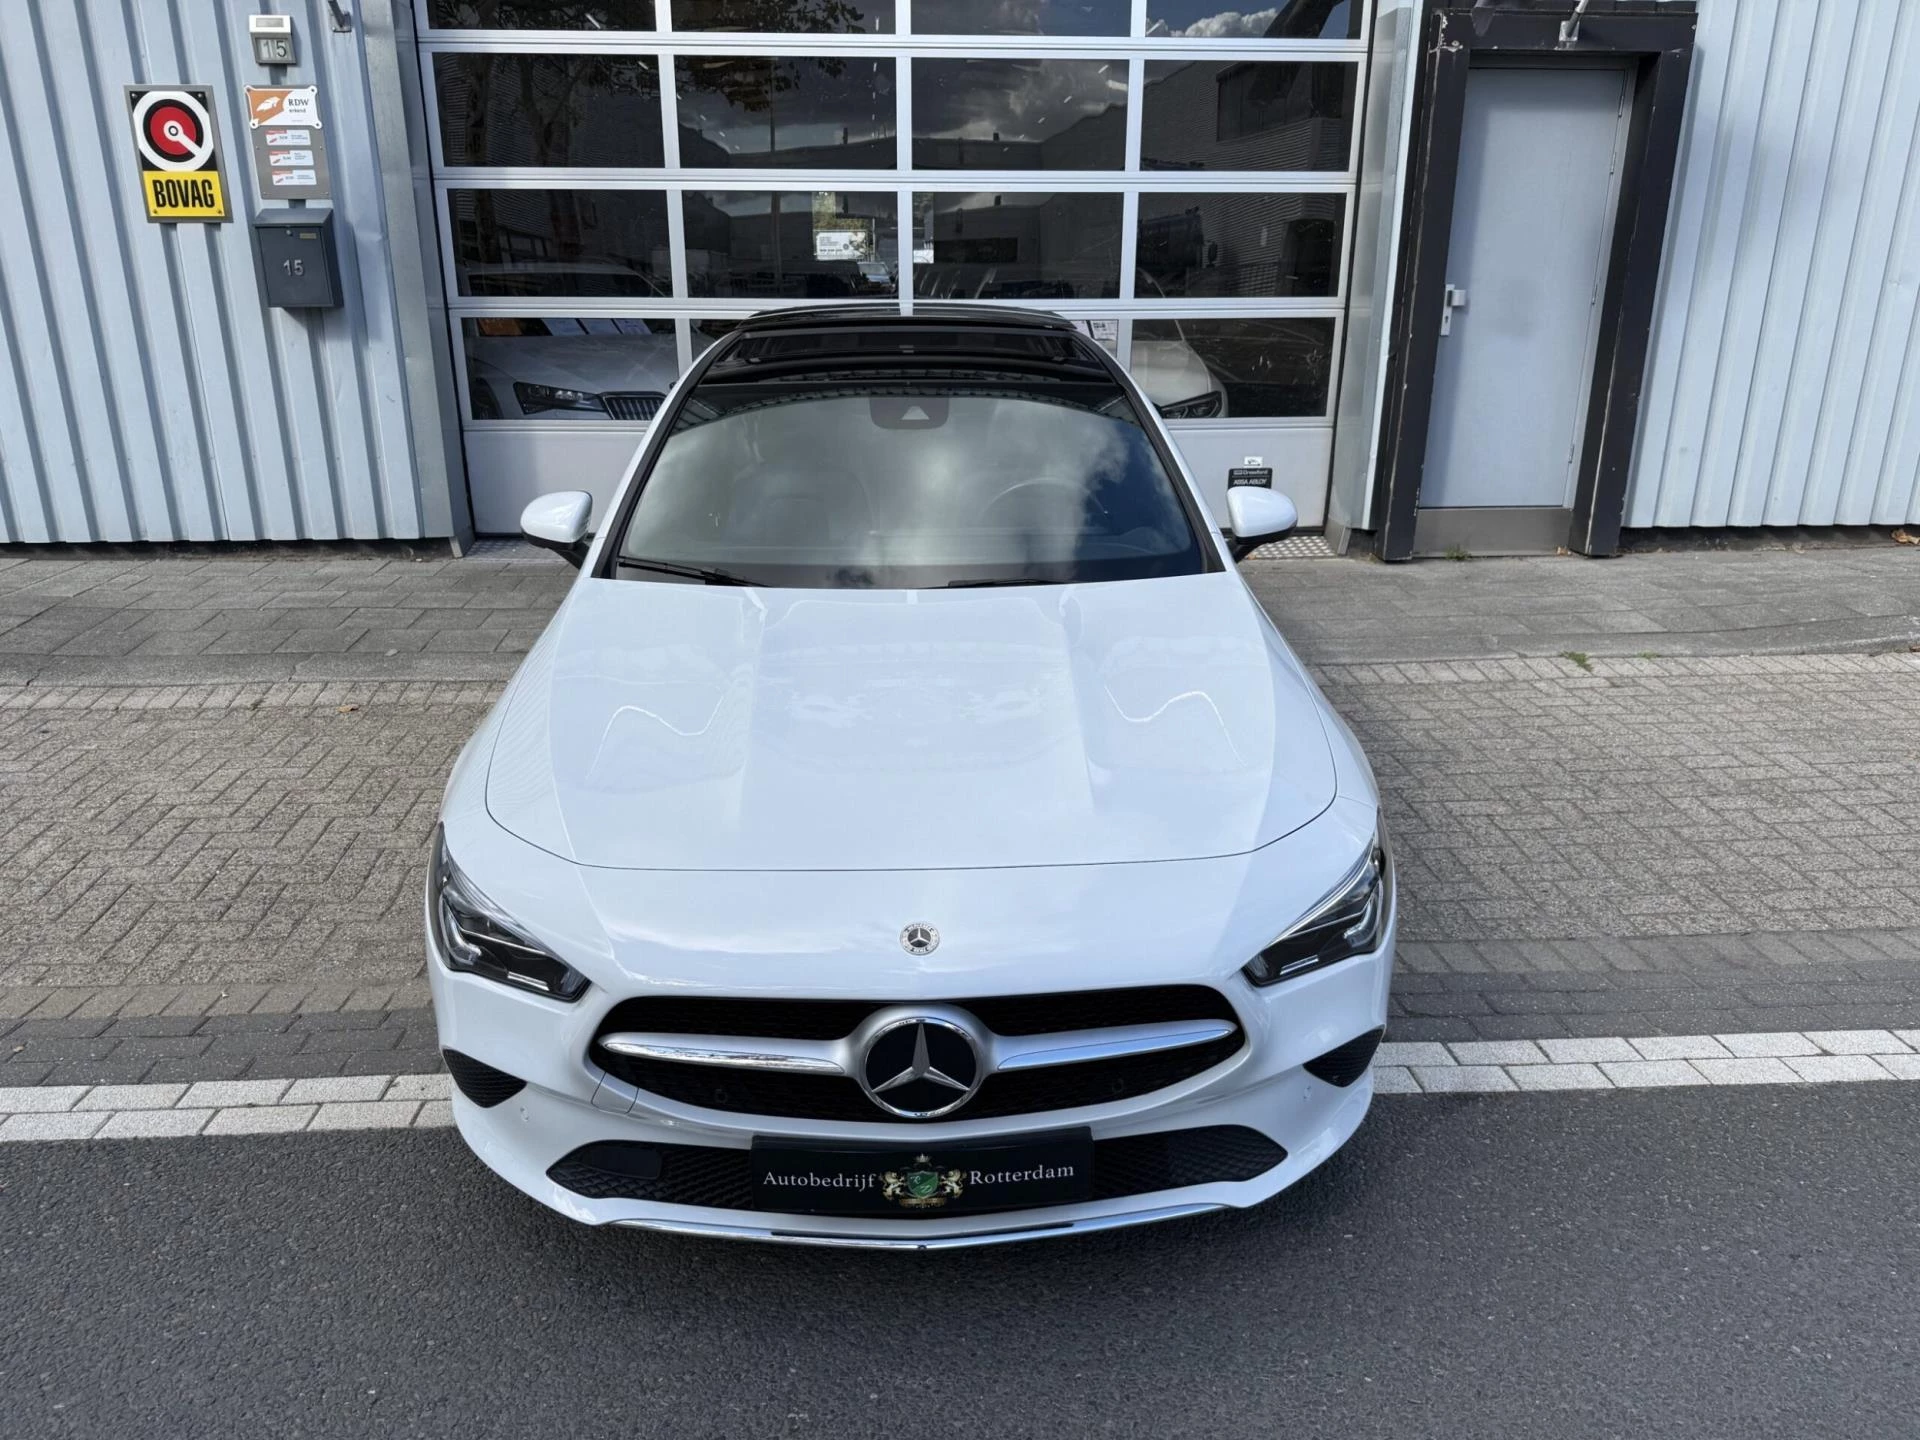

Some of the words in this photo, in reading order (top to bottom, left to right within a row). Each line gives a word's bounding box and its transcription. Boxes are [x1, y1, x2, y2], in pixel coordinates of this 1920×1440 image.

[263, 40, 287, 58] 15
[288, 98, 309, 106] RDW
[152, 179, 215, 208] BOVAG
[283, 259, 304, 276] 15
[763, 1172, 877, 1191] Autobedrijf
[970, 1164, 1074, 1185] Rotterdam
